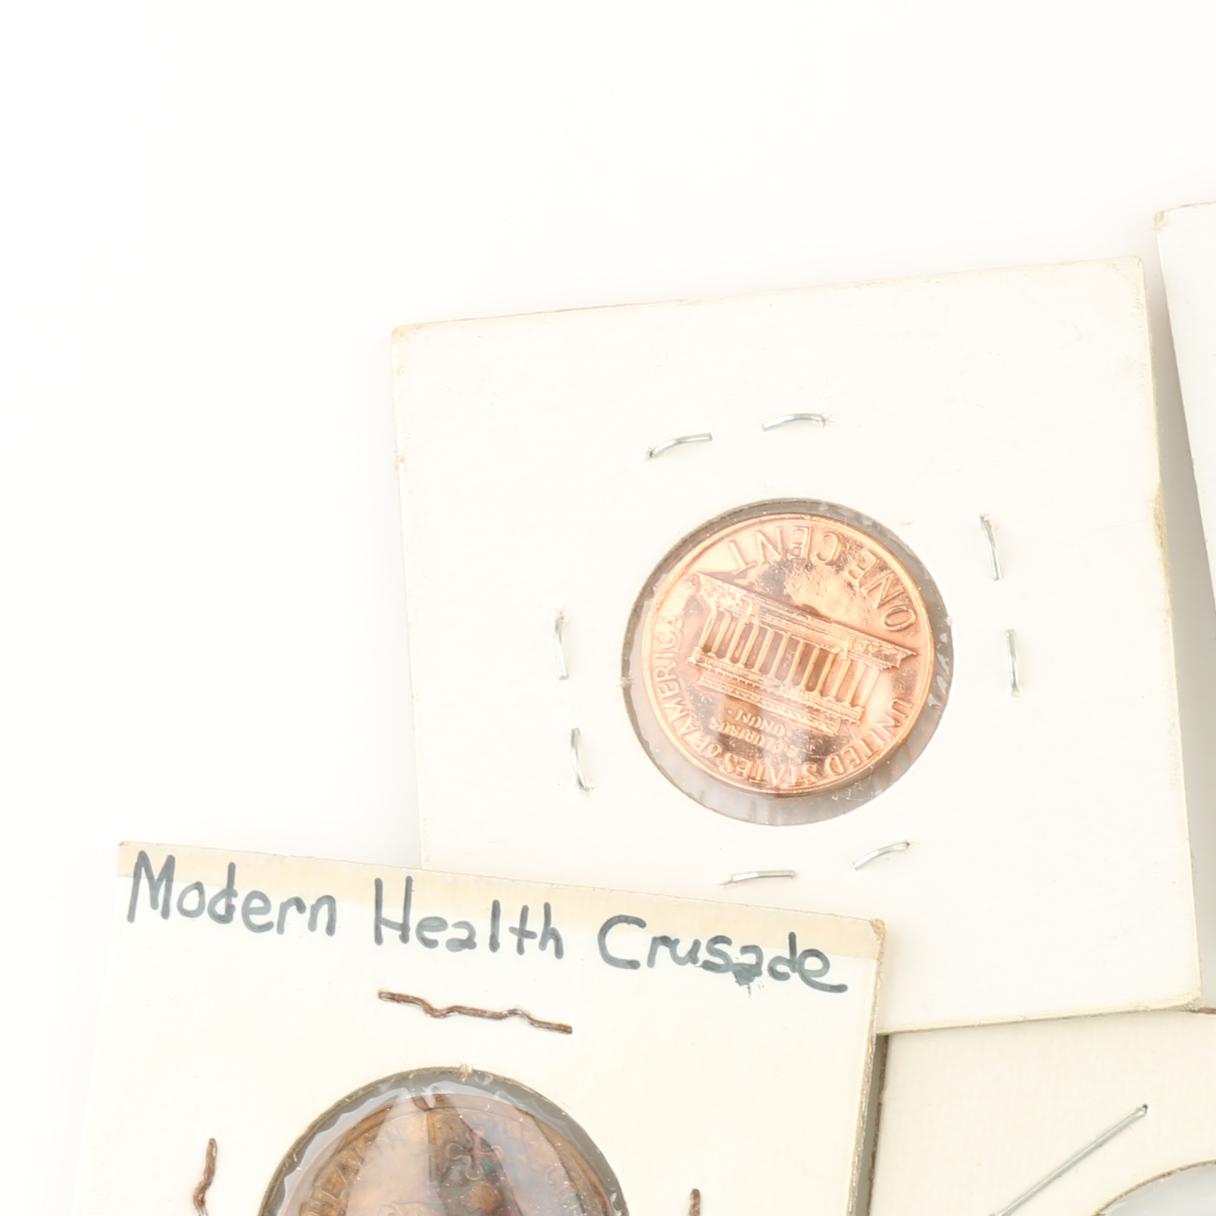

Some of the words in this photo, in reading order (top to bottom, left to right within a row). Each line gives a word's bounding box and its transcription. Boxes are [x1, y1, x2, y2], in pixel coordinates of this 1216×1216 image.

[727, 525, 844, 575] CENT
[850, 552, 918, 634] ONE
[655, 614, 704, 734] AMERICA
[718, 752, 822, 788] STATES
[823, 698, 914, 776] UNITED
[126, 849, 337, 937] Modern
[373, 875, 564, 960] Health
[596, 913, 849, 994] Crusade
